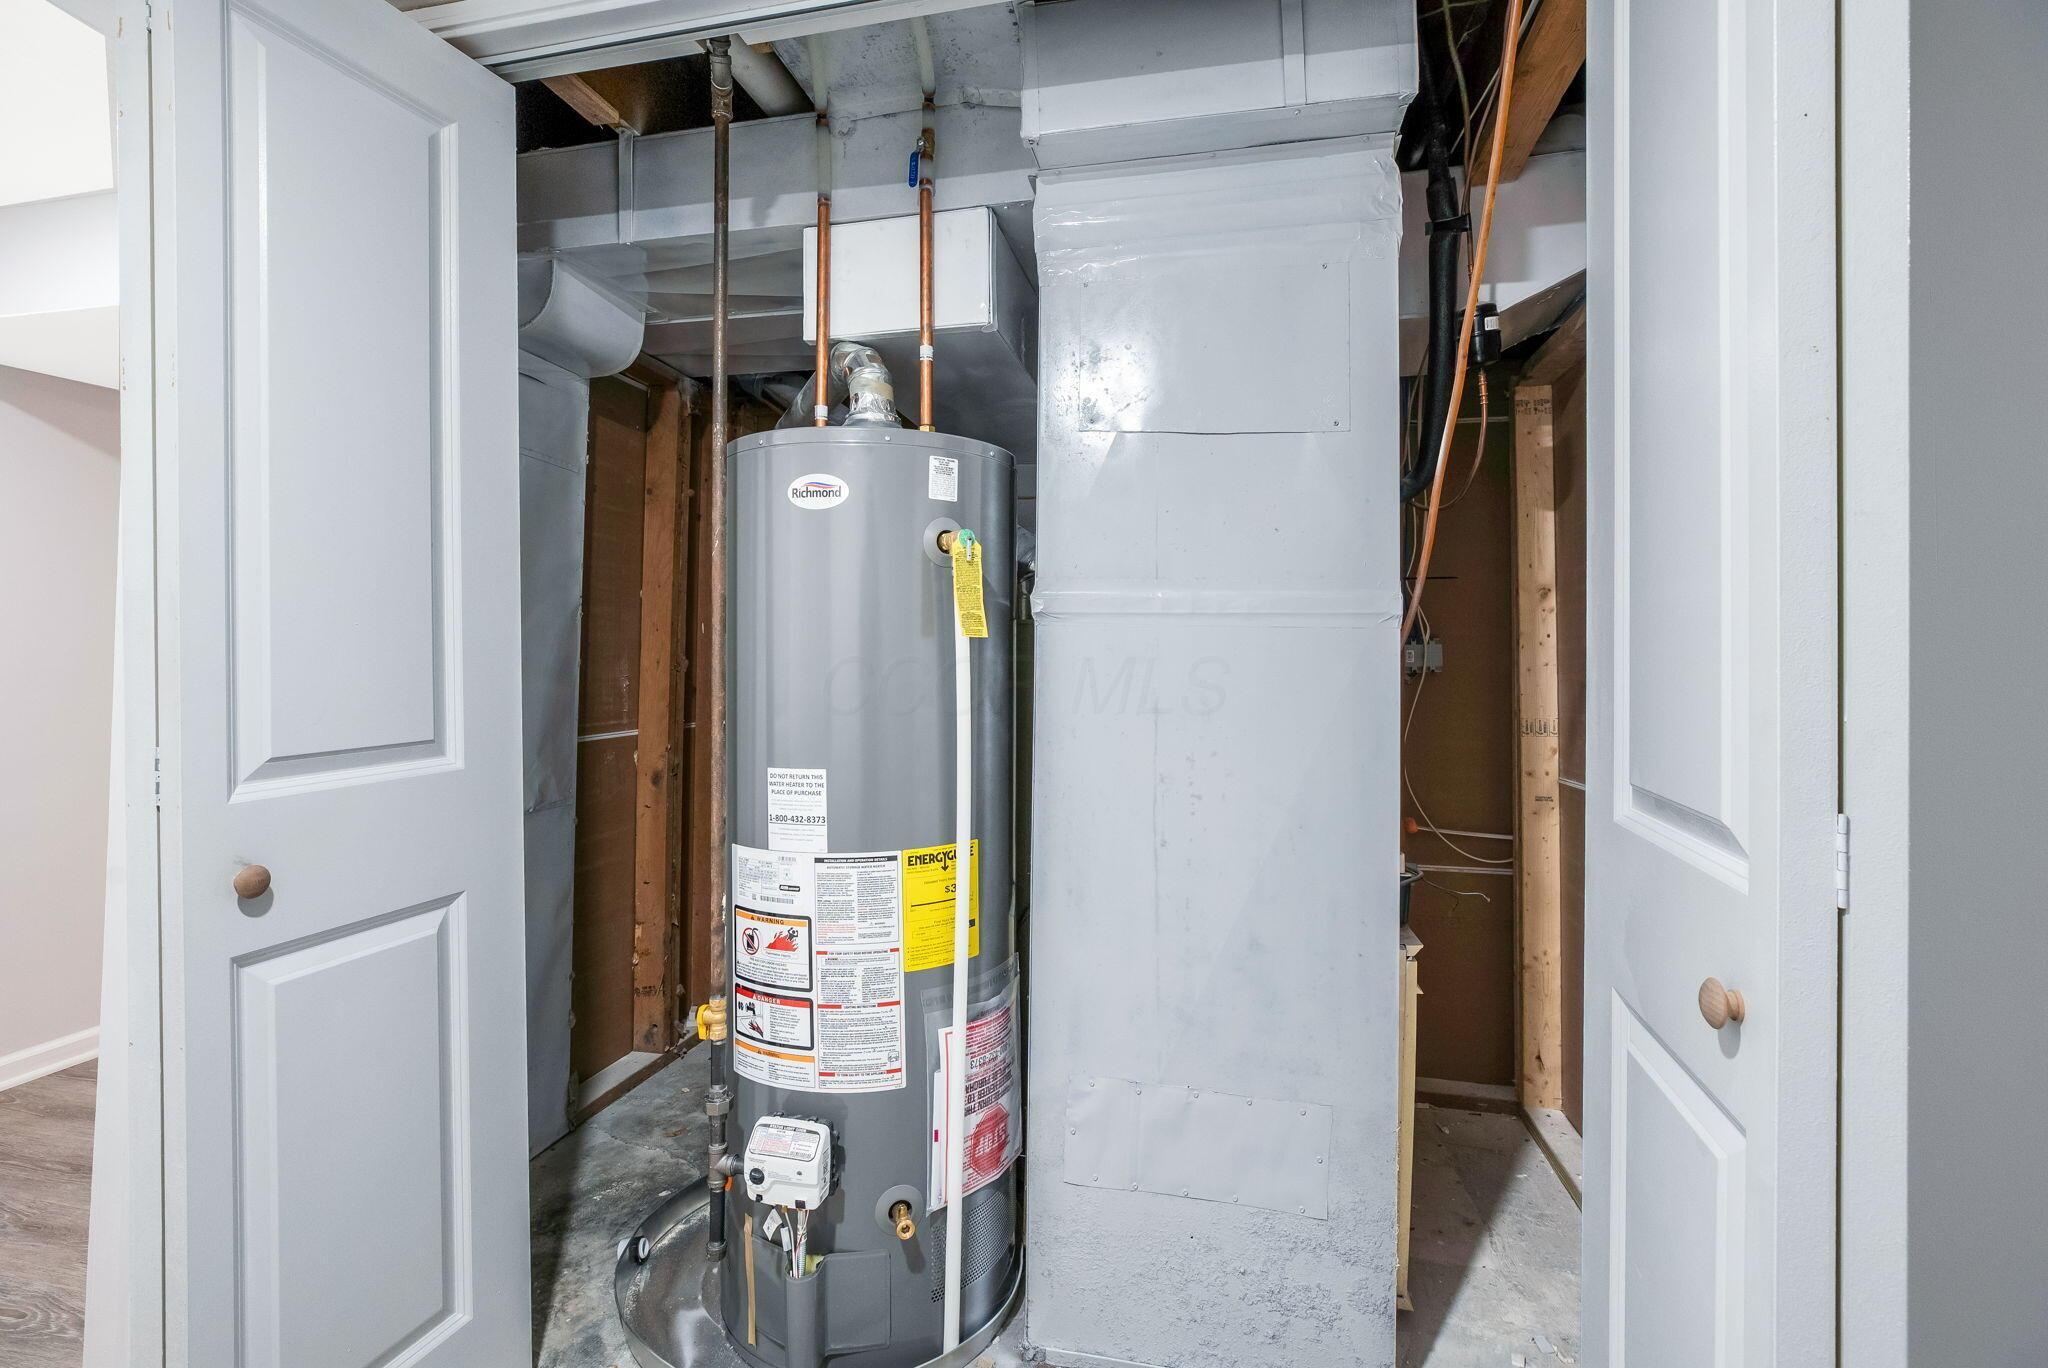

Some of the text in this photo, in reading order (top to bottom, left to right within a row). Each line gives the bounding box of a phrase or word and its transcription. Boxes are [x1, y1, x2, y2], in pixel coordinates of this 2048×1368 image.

[791, 485, 842, 499] Richmond
[769, 814, 826, 824] 1-800-432-8373
[757, 916, 785, 925] WARNING
[757, 995, 781, 1004] DANGER
